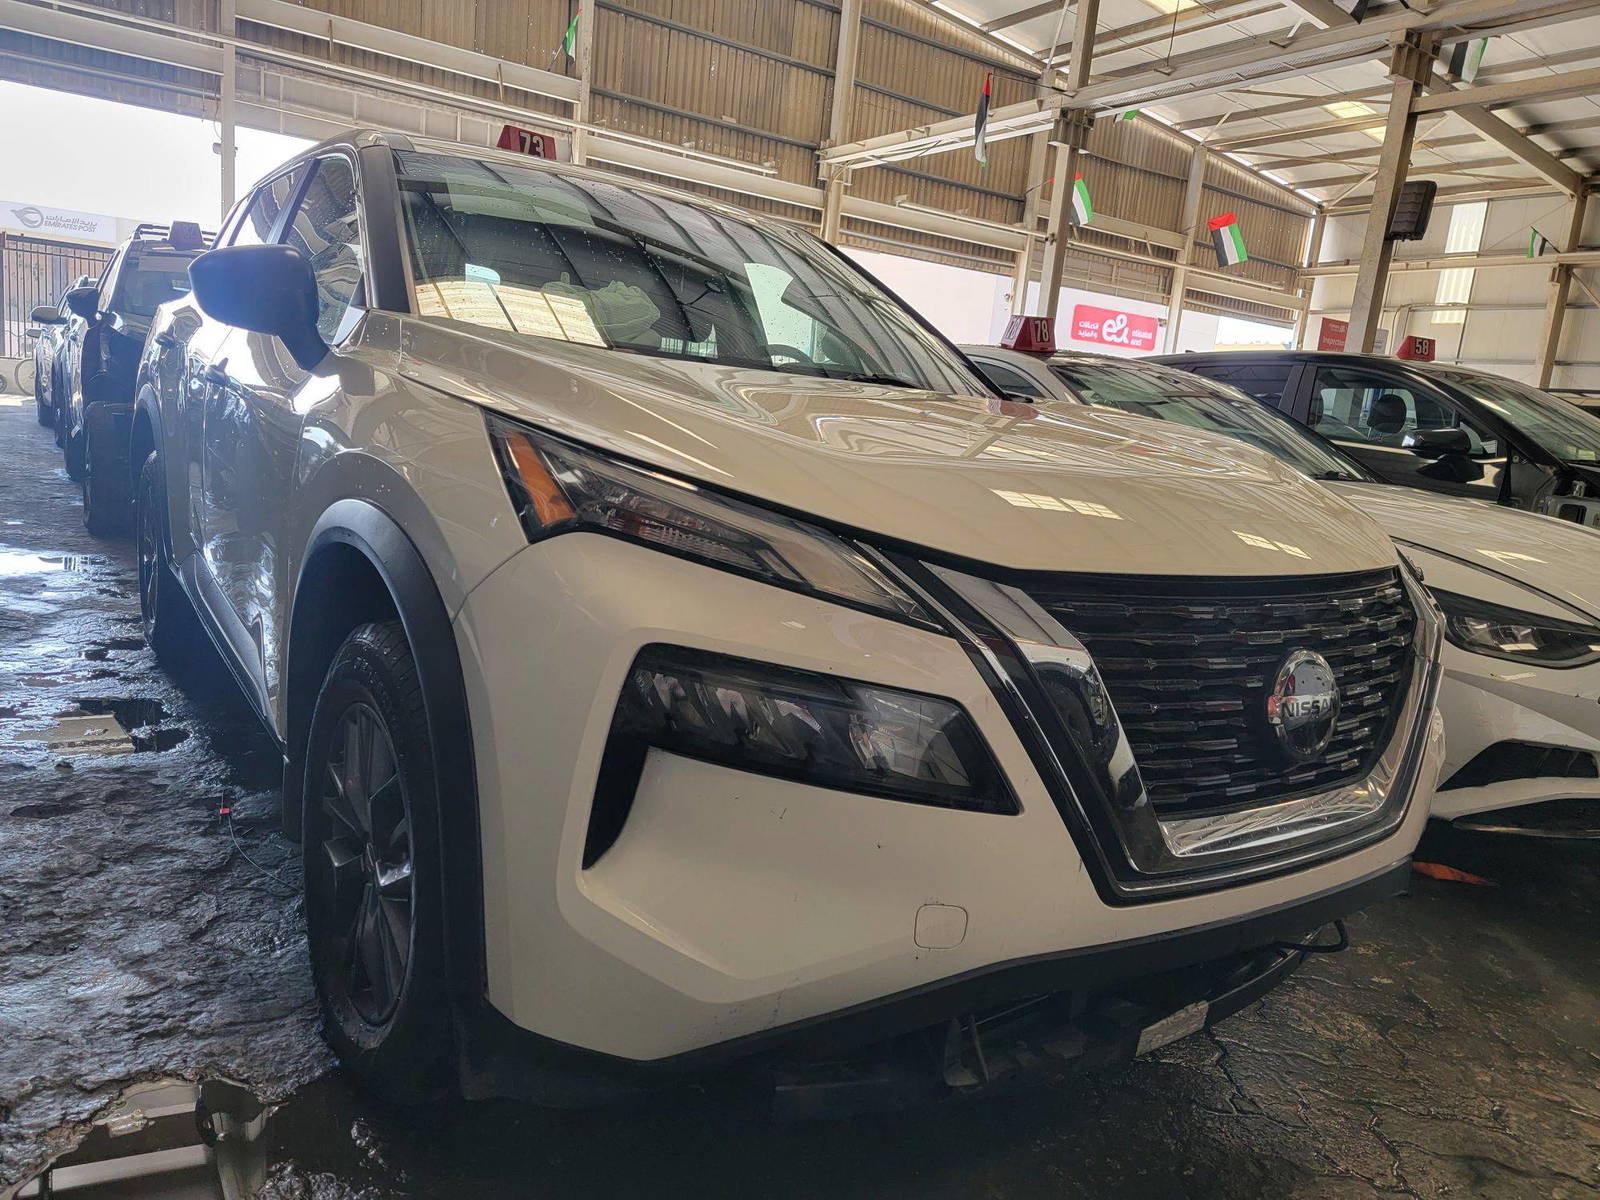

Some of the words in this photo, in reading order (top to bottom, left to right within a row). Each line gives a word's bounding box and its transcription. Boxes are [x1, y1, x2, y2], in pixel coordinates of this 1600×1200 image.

[519, 131, 545, 158] 73
[44, 220, 78, 231] EMIRATES
[78, 225, 97, 233] POST
[1034, 319, 1049, 342] 78
[1415, 338, 1429, 355] 58
